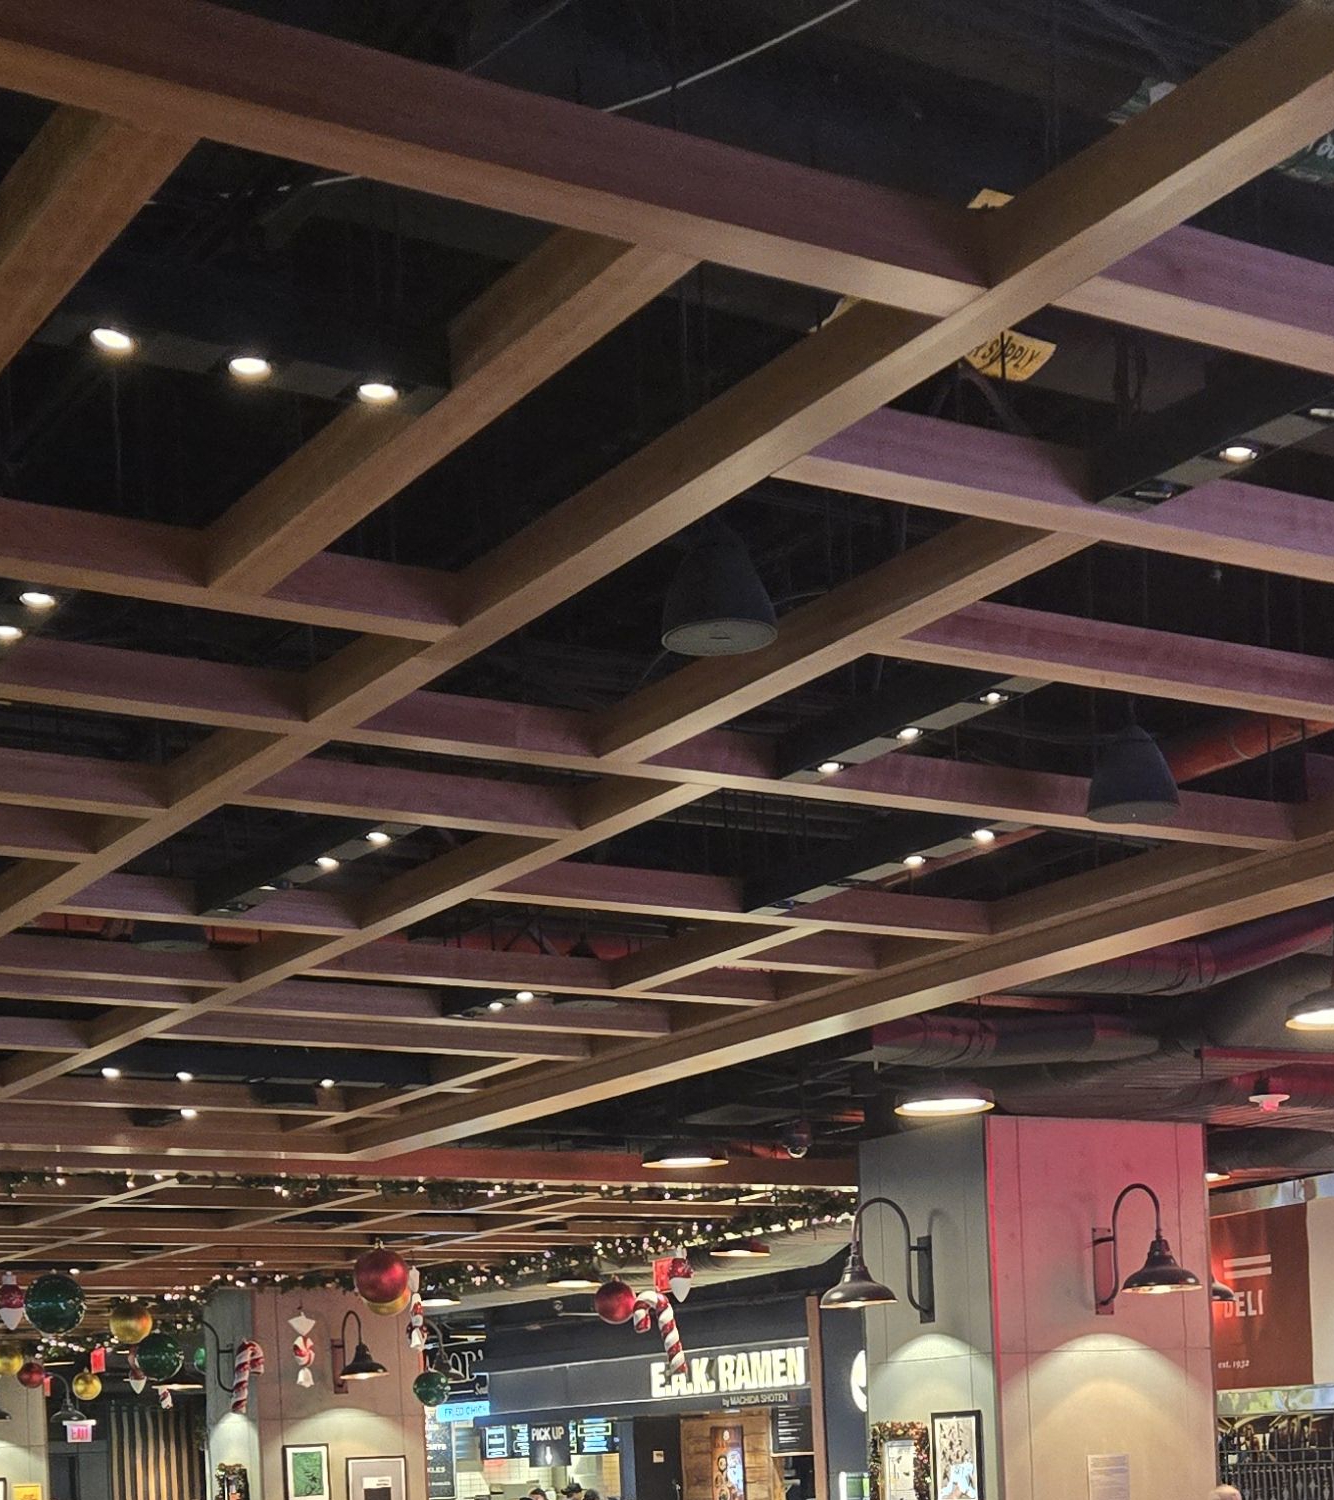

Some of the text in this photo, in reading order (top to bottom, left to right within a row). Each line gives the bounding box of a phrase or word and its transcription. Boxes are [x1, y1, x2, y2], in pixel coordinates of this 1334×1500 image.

[1224, 1289, 1264, 1318] DELI
[718, 1346, 806, 1392] RAMEN
[531, 1425, 552, 1441] PICK
[552, 1424, 565, 1440] UP
